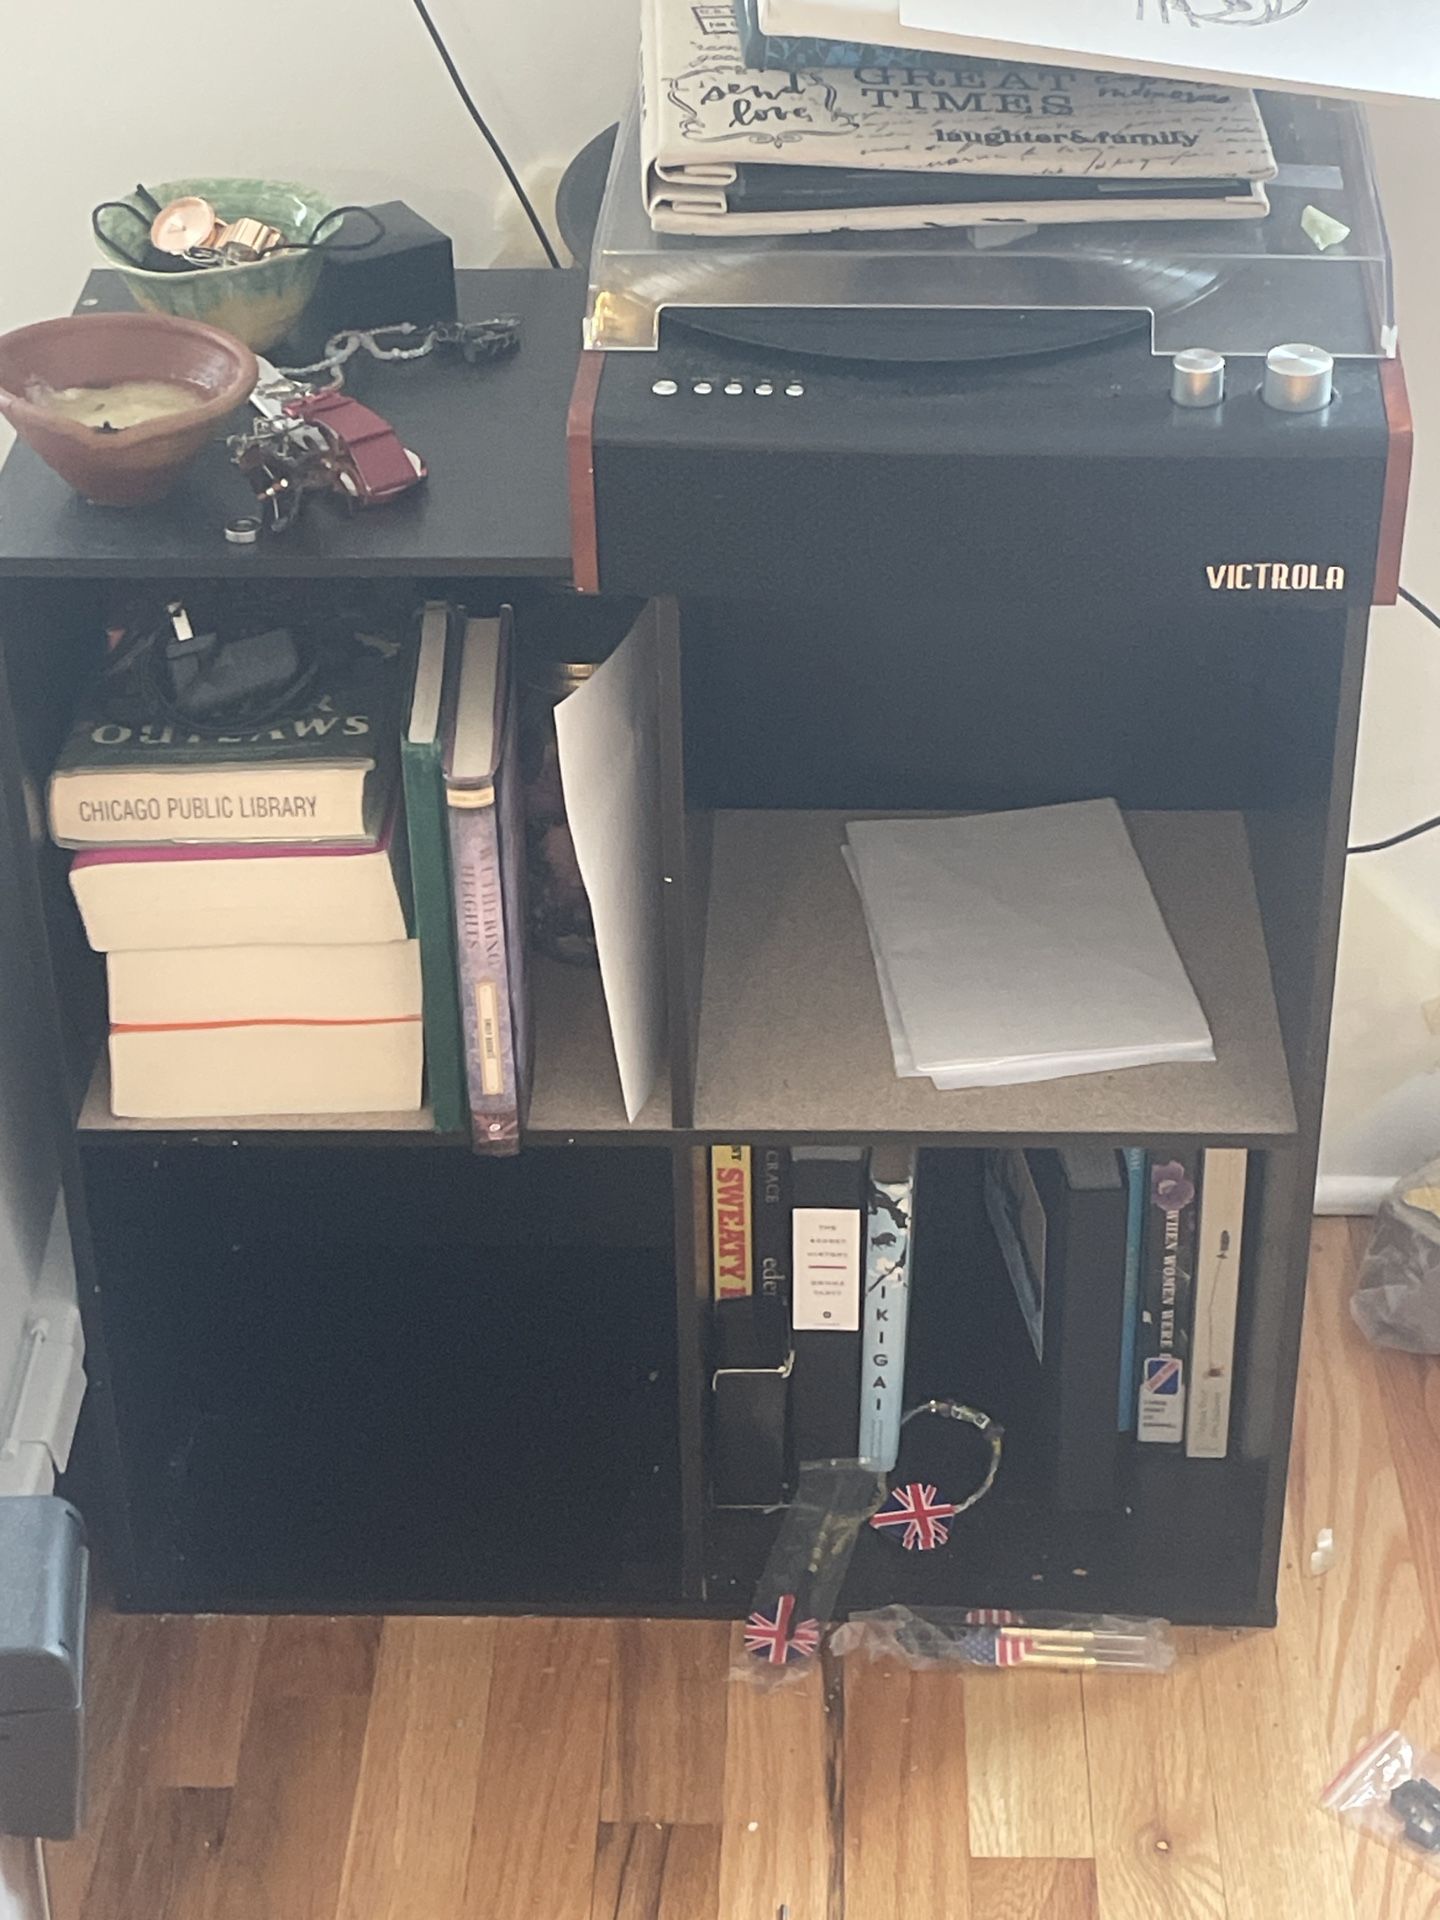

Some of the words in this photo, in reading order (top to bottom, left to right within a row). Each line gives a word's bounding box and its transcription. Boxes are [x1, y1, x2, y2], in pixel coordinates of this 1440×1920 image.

[700, 72, 807, 105] send
[855, 66, 1076, 92] GREAT
[729, 98, 814, 128] love
[861, 87, 1075, 116] TIMES
[1206, 563, 1345, 590] VICTROLA
[79, 798, 160, 822] CHICAGO
[167, 797, 233, 820] PUBLIC
[240, 796, 318, 819] LIBRARY
[716, 1168, 746, 1281] SWEATY
[1166, 1210, 1180, 1250] WHEN
[1162, 1255, 1177, 1305] WOMEN
[1159, 1309, 1175, 1348] WERE
[872, 1285, 889, 1411] IKIGAI
